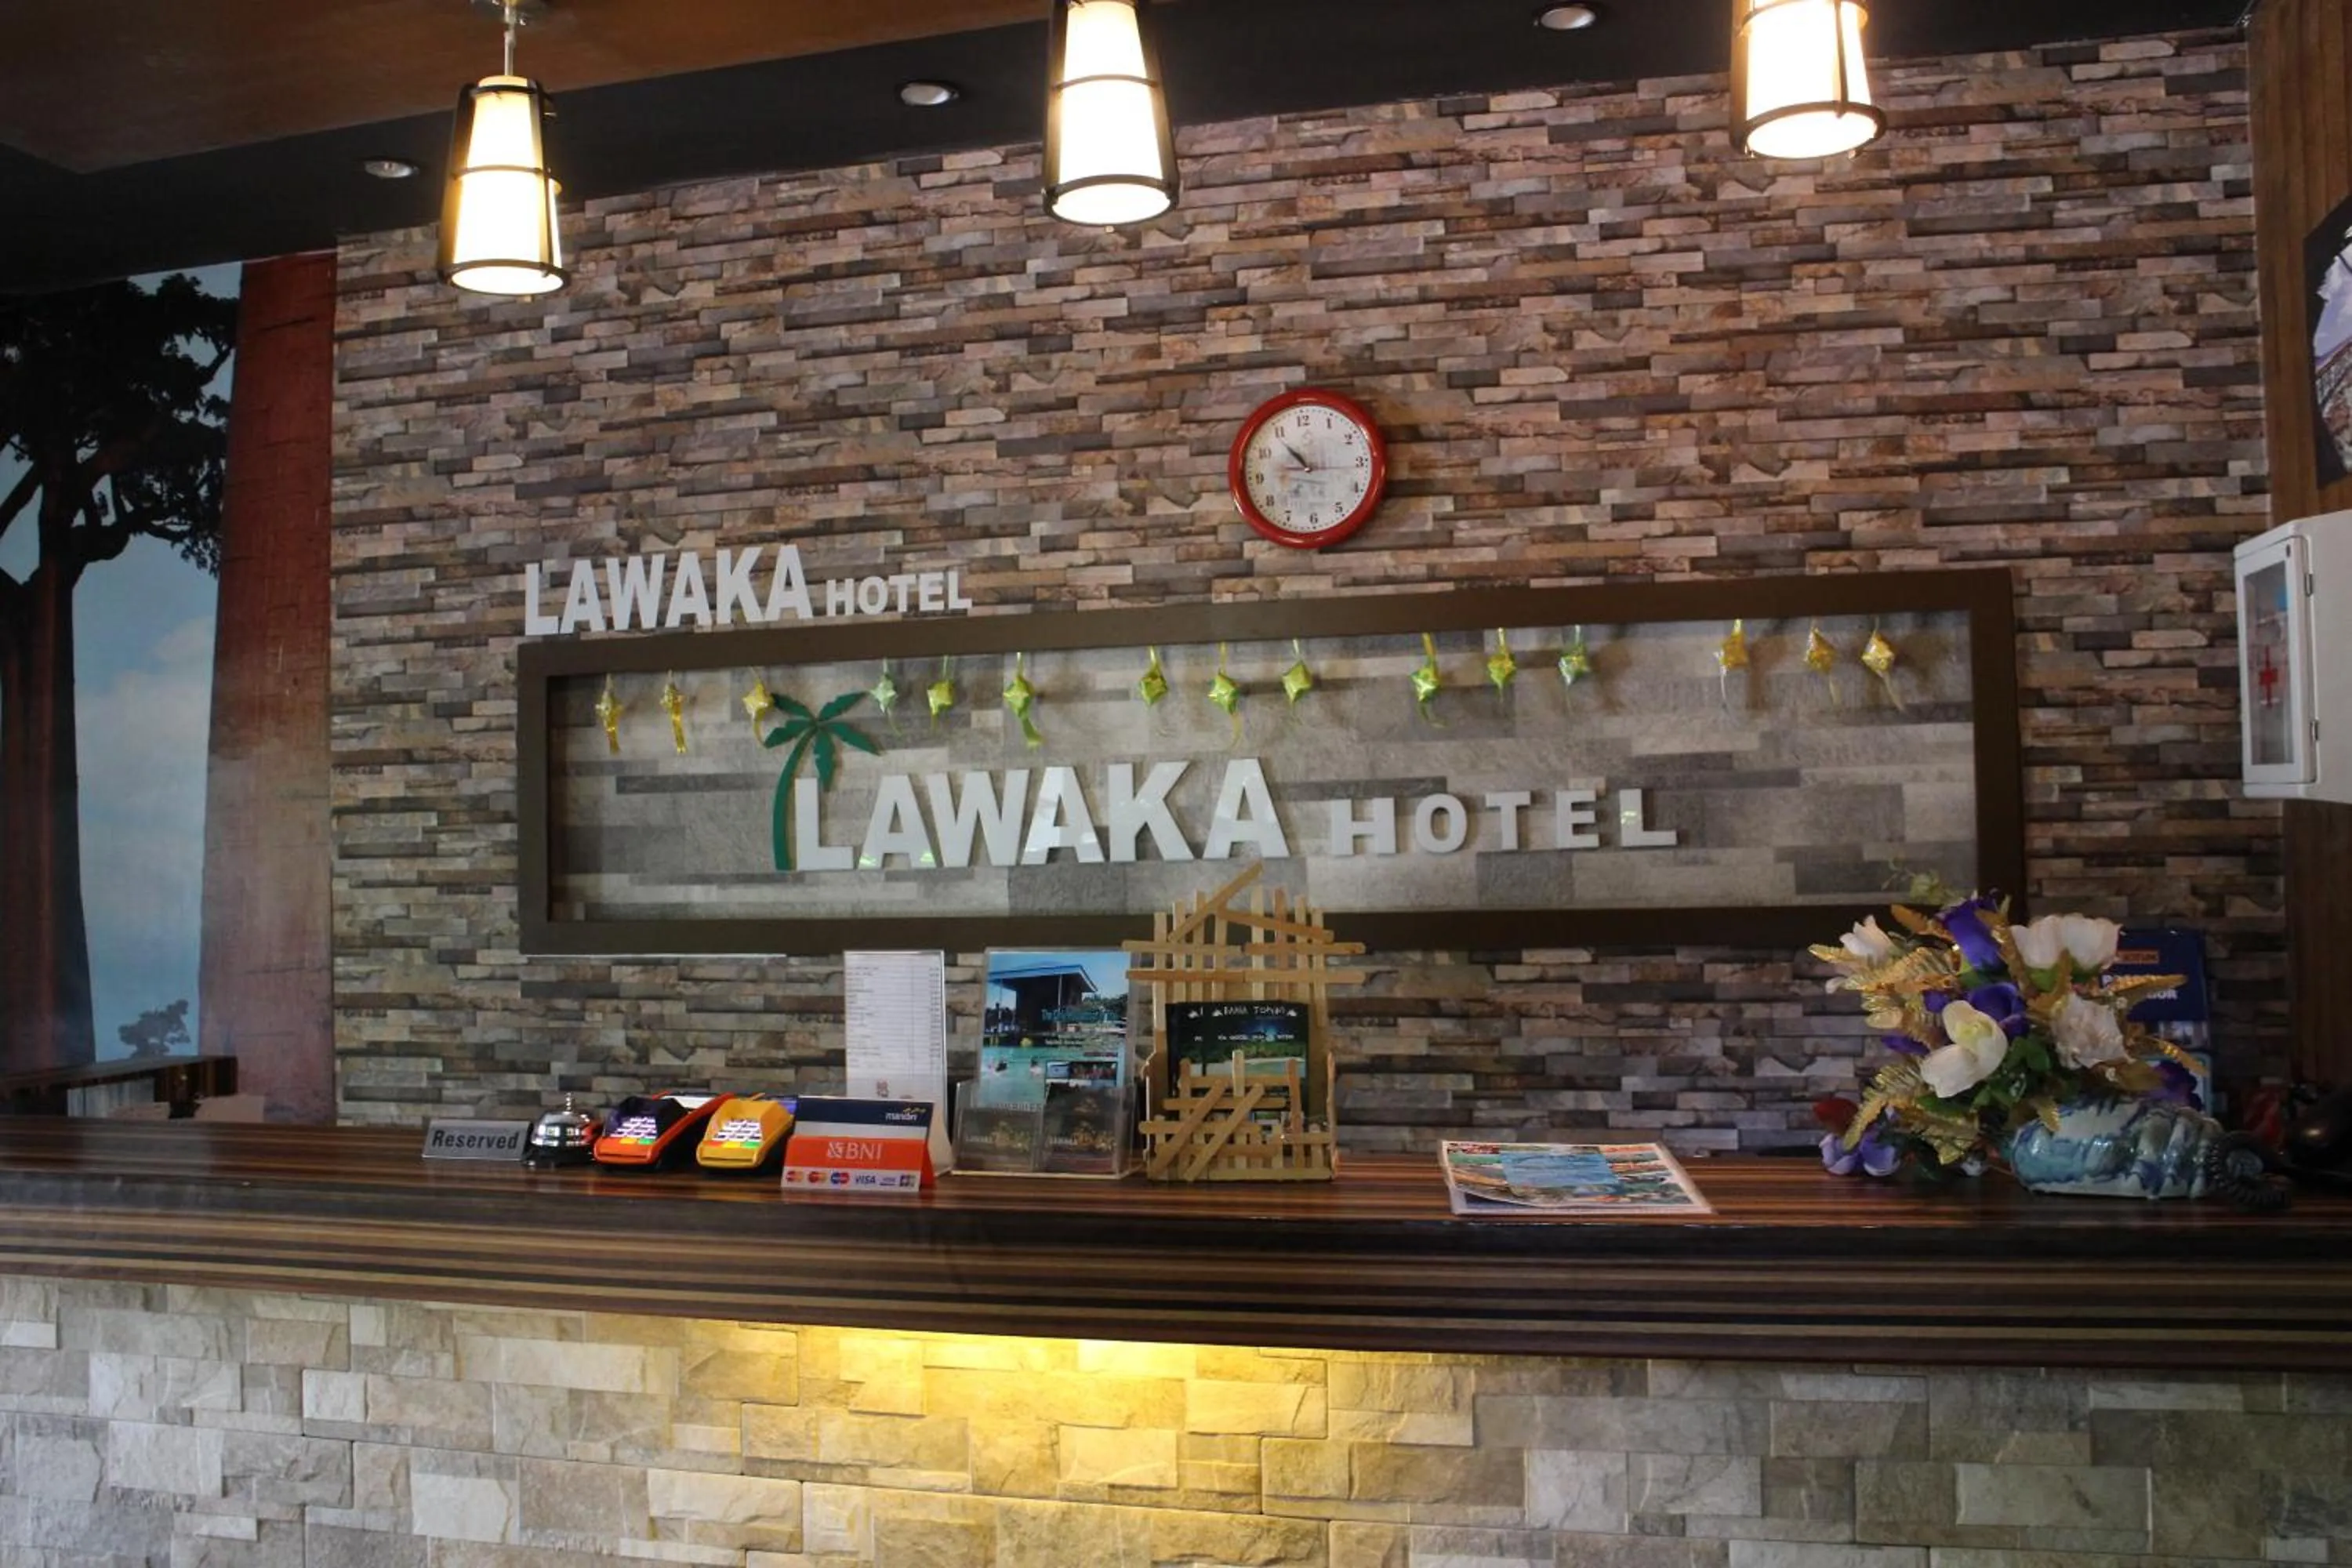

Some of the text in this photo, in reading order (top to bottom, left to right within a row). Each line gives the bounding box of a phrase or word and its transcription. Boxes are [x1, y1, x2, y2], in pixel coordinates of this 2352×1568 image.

[1297, 415, 1310, 427] 12
[1275, 426, 1285, 438] 11
[1345, 434, 1353, 445] 2
[1258, 447, 1272, 459] 10
[1355, 456, 1364, 468] 3
[1255, 473, 1265, 485] 9
[1265, 495, 1275, 506] 8
[1334, 502, 1343, 514] 5
[1284, 510, 1292, 522] 7
[1309, 512, 1319, 524] 6
[524, 543, 972, 636] LAWAKA HOTEL
[794, 757, 1678, 871] LAWAKA HOTEL
[433, 1130, 520, 1149] Reserved
[846, 1142, 882, 1160] BNI
[855, 1175, 877, 1185] VISA
